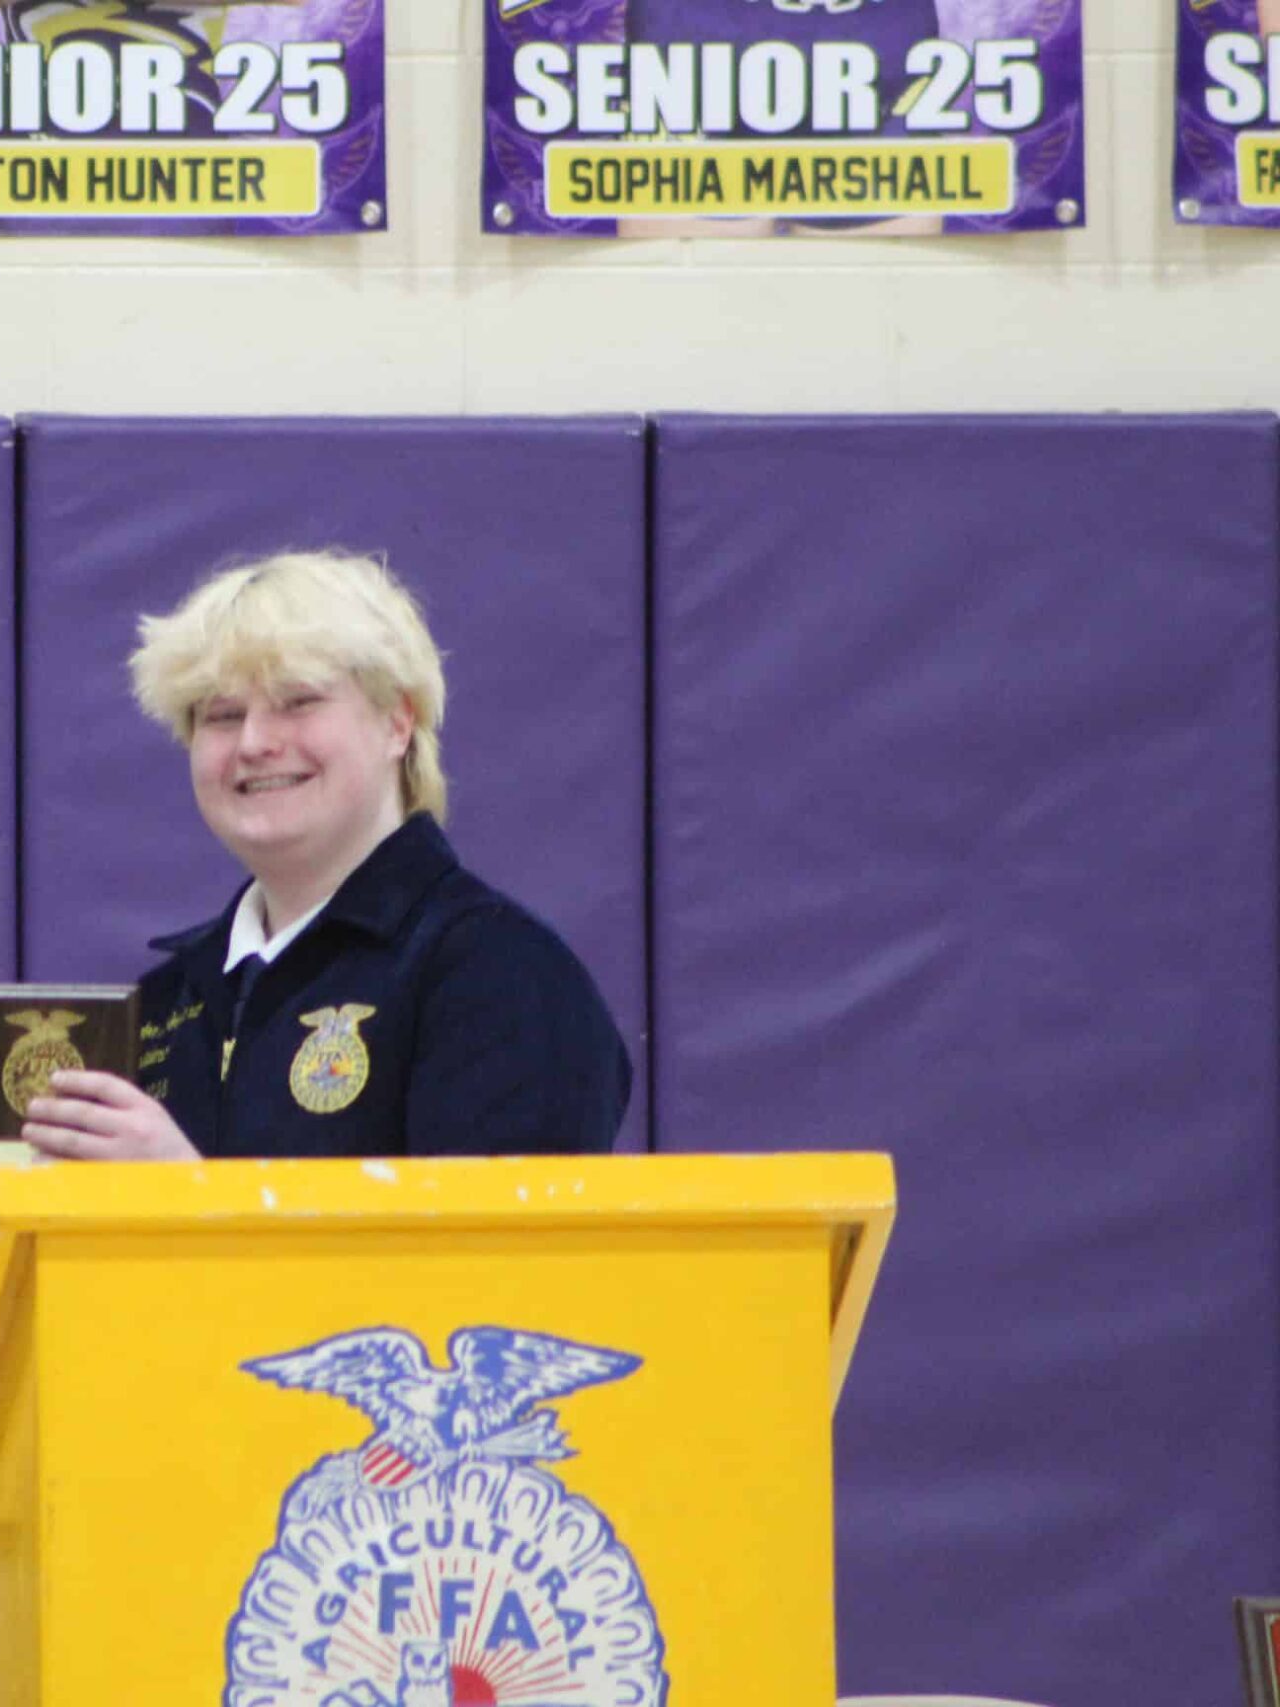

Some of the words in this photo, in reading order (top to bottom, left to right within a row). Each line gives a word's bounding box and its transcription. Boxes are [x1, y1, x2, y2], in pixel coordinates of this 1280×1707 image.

[213, 40, 348, 134] 25
[513, 41, 878, 133] SENIOR
[904, 39, 1042, 131] 25
[86, 156, 266, 203] HUNTER
[568, 157, 725, 204] SOPHIA
[743, 156, 983, 203] MARSHALL
[301, 1518, 596, 1672] AGRICULTURAL
[377, 1571, 541, 1651] FFA
